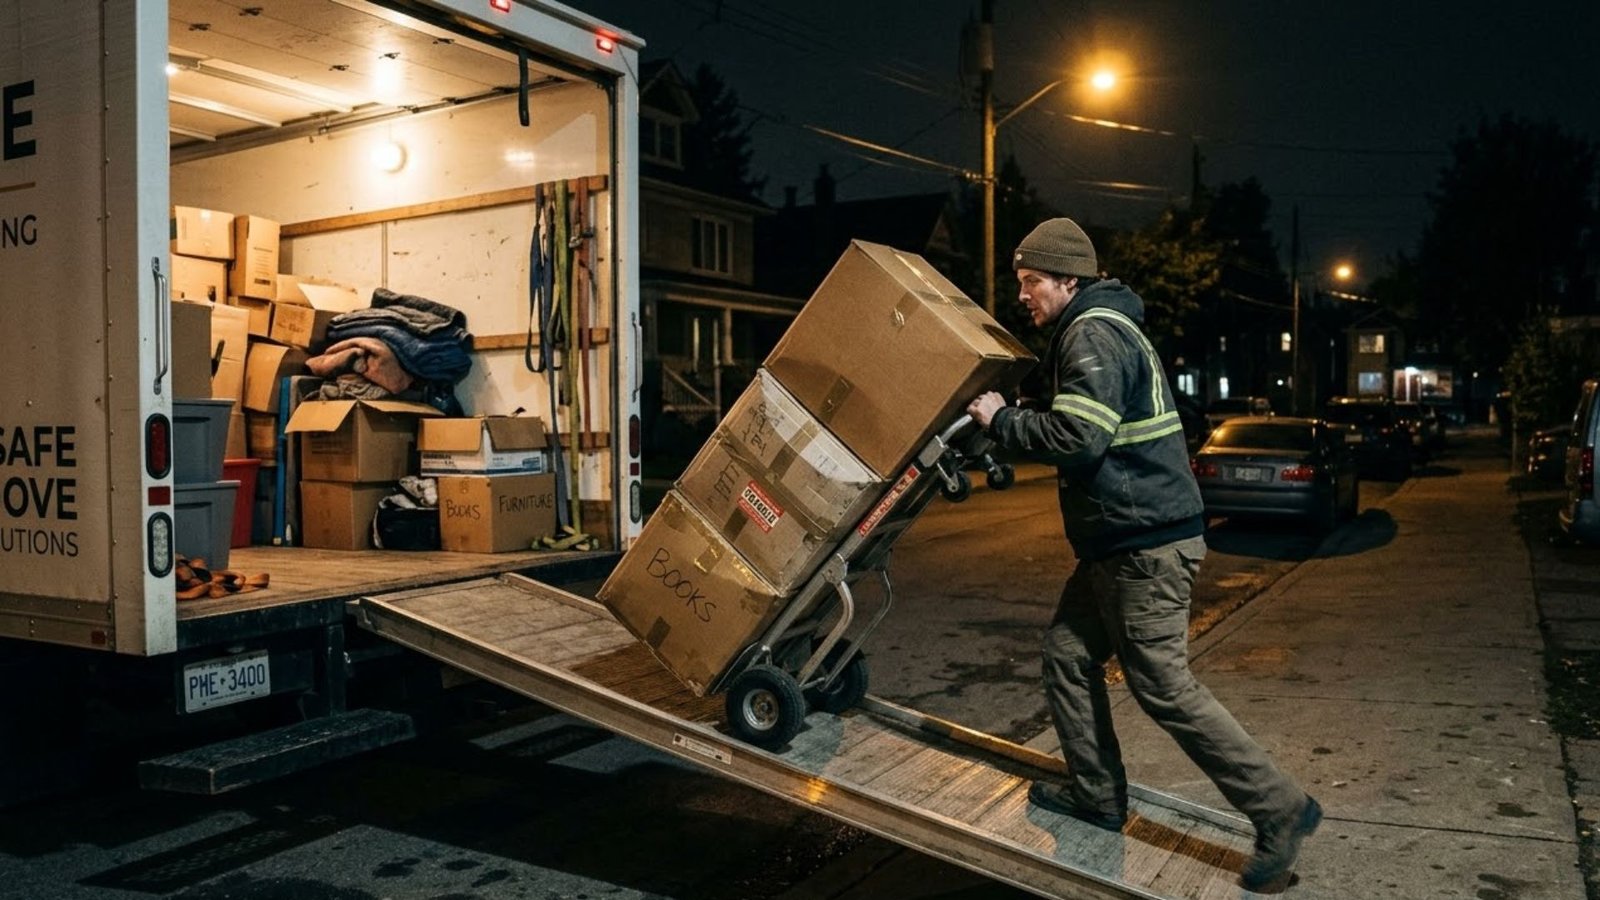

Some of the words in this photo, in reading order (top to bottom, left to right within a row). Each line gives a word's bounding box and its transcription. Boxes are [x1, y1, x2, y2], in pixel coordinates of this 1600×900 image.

[3, 80, 36, 161] E
[2, 214, 37, 248] NG
[3, 477, 78, 520] OVE
[1, 527, 79, 557] UTIONS
[647, 548, 717, 622] BOOKS
[228, 663, 266, 691] 3400
